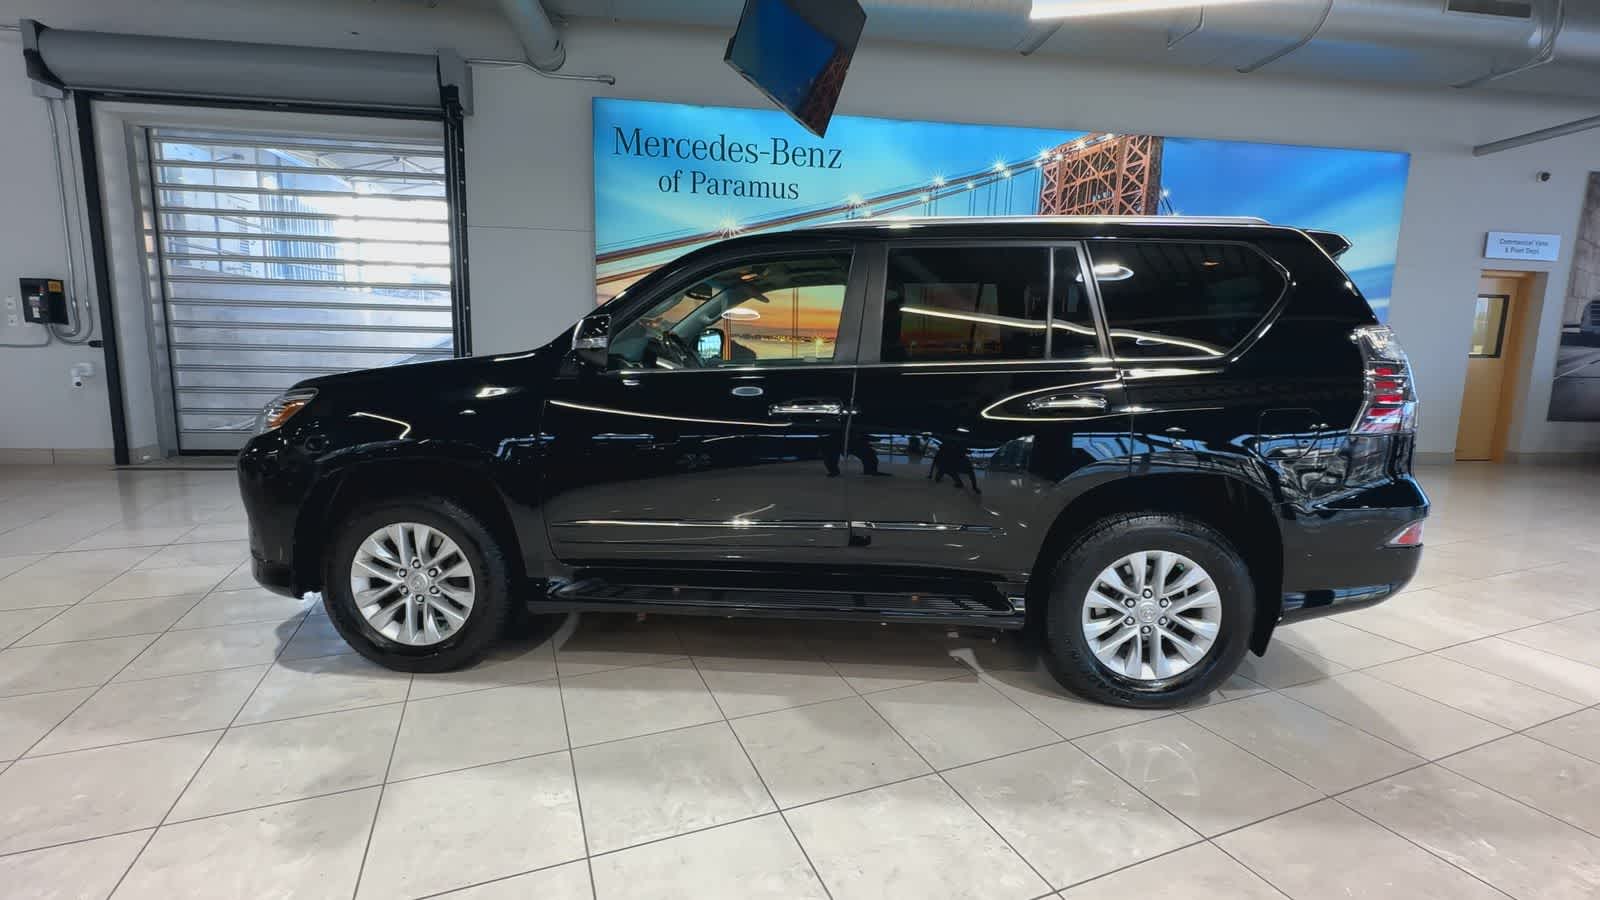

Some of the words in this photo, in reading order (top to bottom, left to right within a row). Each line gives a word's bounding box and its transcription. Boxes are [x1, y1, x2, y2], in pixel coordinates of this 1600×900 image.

[613, 126, 843, 169] Mercedes-Benz
[658, 169, 684, 194] of
[690, 170, 800, 201] Paramus
